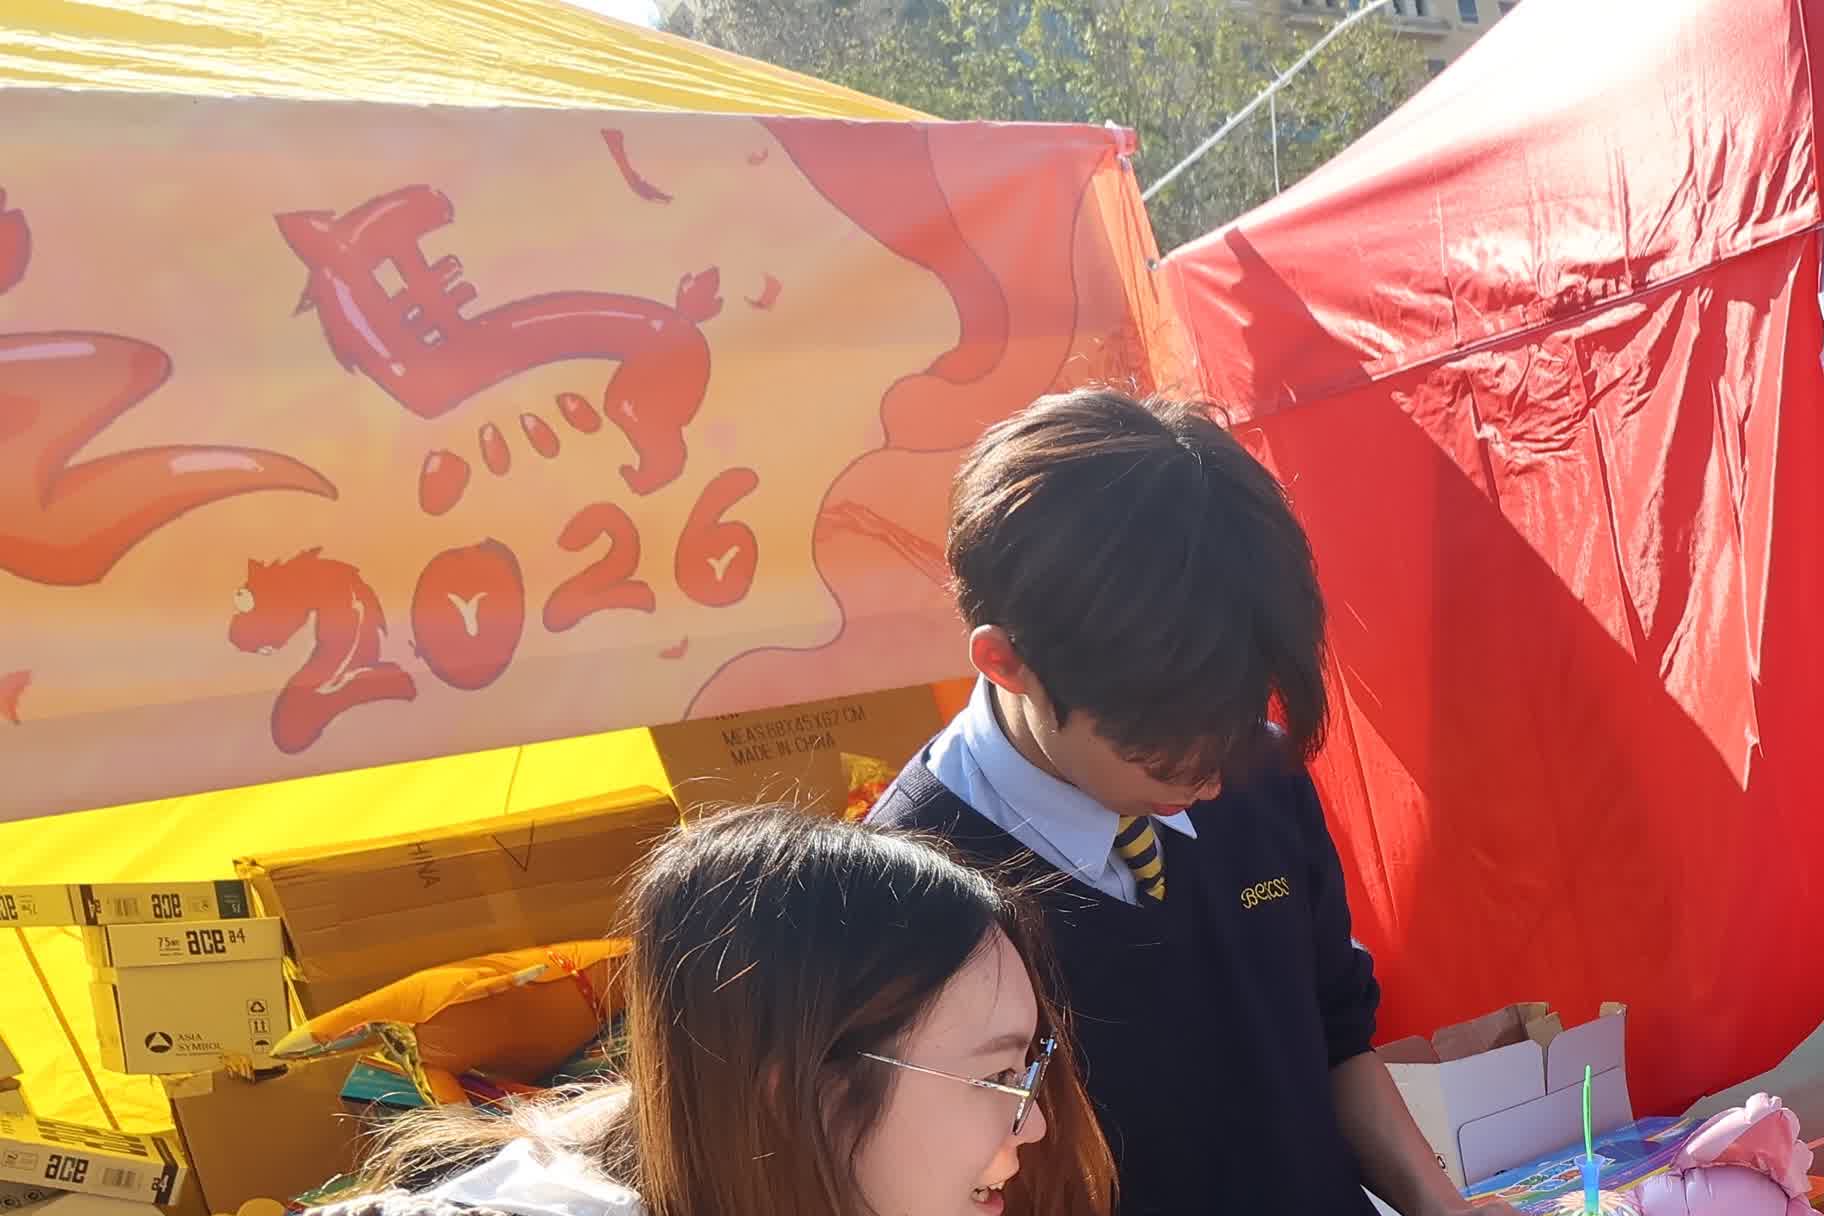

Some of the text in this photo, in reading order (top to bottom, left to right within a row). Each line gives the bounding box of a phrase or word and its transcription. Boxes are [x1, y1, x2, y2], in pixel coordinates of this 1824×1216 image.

[228, 466, 760, 755] 2026
[730, 743, 772, 766] MADE
[151, 893, 183, 919] ace
[186, 928, 227, 955] ace
[228, 927, 246, 945] a4
[177, 1041, 223, 1052] SYMBOL
[44, 1154, 89, 1184] ace
